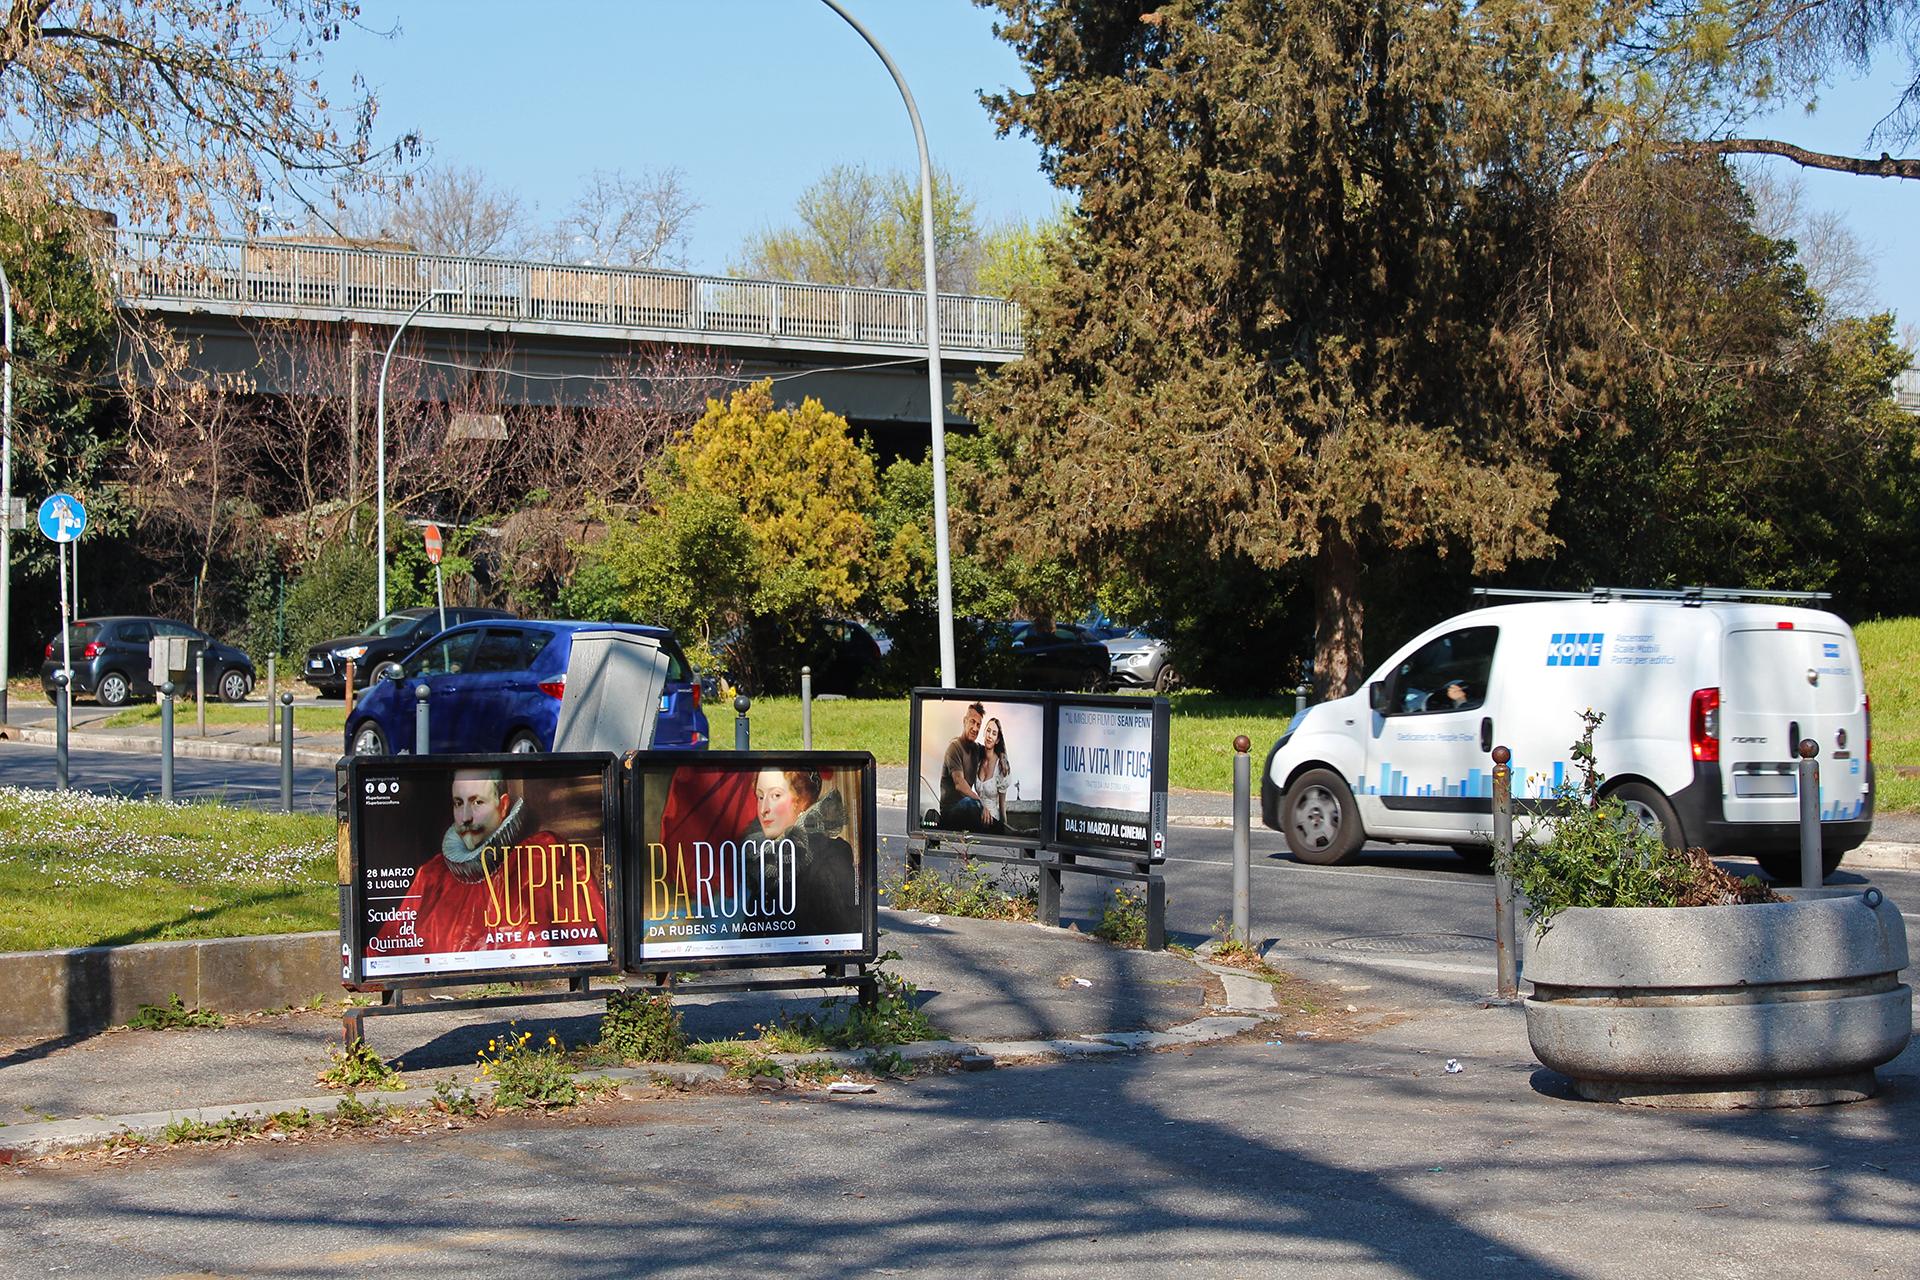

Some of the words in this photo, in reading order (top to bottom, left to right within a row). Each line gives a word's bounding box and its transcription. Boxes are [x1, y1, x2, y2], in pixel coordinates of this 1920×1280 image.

[1548, 642, 1602, 657] KONE
[1117, 715, 1133, 727] SEAN
[1064, 745, 1086, 773] UNA
[1088, 747, 1110, 775] VITA
[1113, 749, 1123, 777] IN
[1126, 750, 1152, 779] FUGA
[1065, 818, 1078, 832] DAL
[1079, 820, 1086, 833] 31
[1087, 821, 1110, 836] MARZO
[1111, 823, 1120, 838] AL
[1120, 824, 1147, 841] CINEMA
[366, 869, 378, 878] 26
[380, 867, 415, 877] MARZO
[647, 838, 797, 922] BAROCCO
[367, 881, 373, 890] 3
[375, 879, 410, 889] LUGLIO
[481, 843, 597, 928] SUPER
[367, 907, 418, 922] Scuderie
[399, 921, 415, 935] del
[485, 931, 522, 944] ARTE
[527, 931, 536, 941] A
[541, 927, 598, 940] GENOVA
[649, 926, 666, 937] DA
[669, 923, 717, 936] RUBENS
[720, 923, 728, 934] A
[731, 920, 796, 933] MAGNASCO
[369, 933, 424, 953] Quirinale
